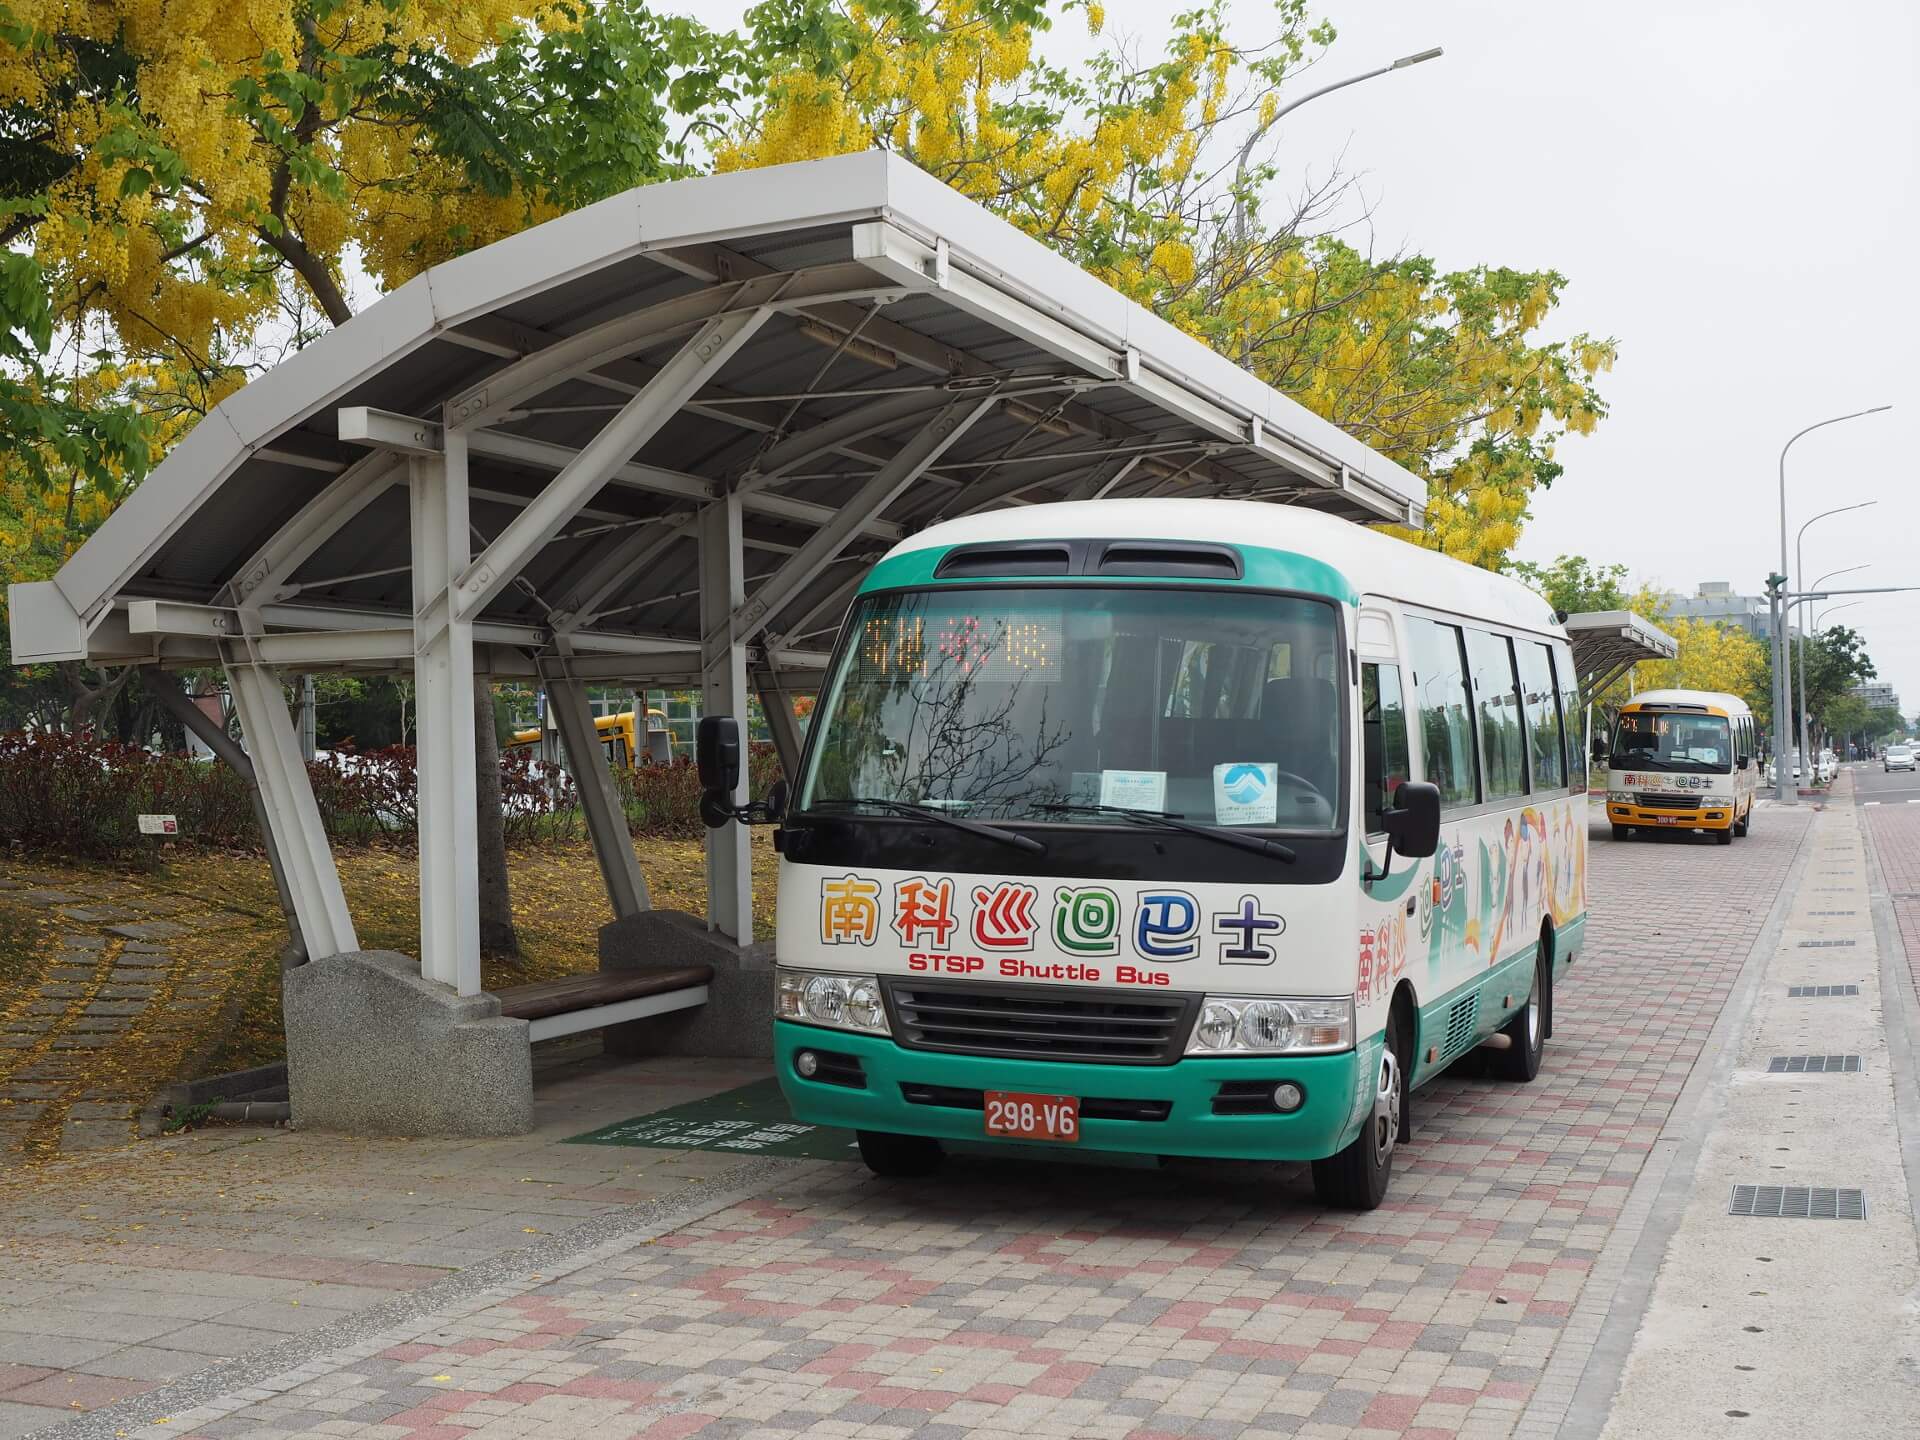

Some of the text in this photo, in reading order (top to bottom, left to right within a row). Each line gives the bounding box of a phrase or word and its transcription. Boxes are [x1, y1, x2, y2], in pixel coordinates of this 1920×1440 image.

[821, 873, 1286, 966] 南科巡迴巴士
[908, 953, 1170, 986] STSP Shuttle Bus
[988, 1100, 1075, 1135] 298-V6
